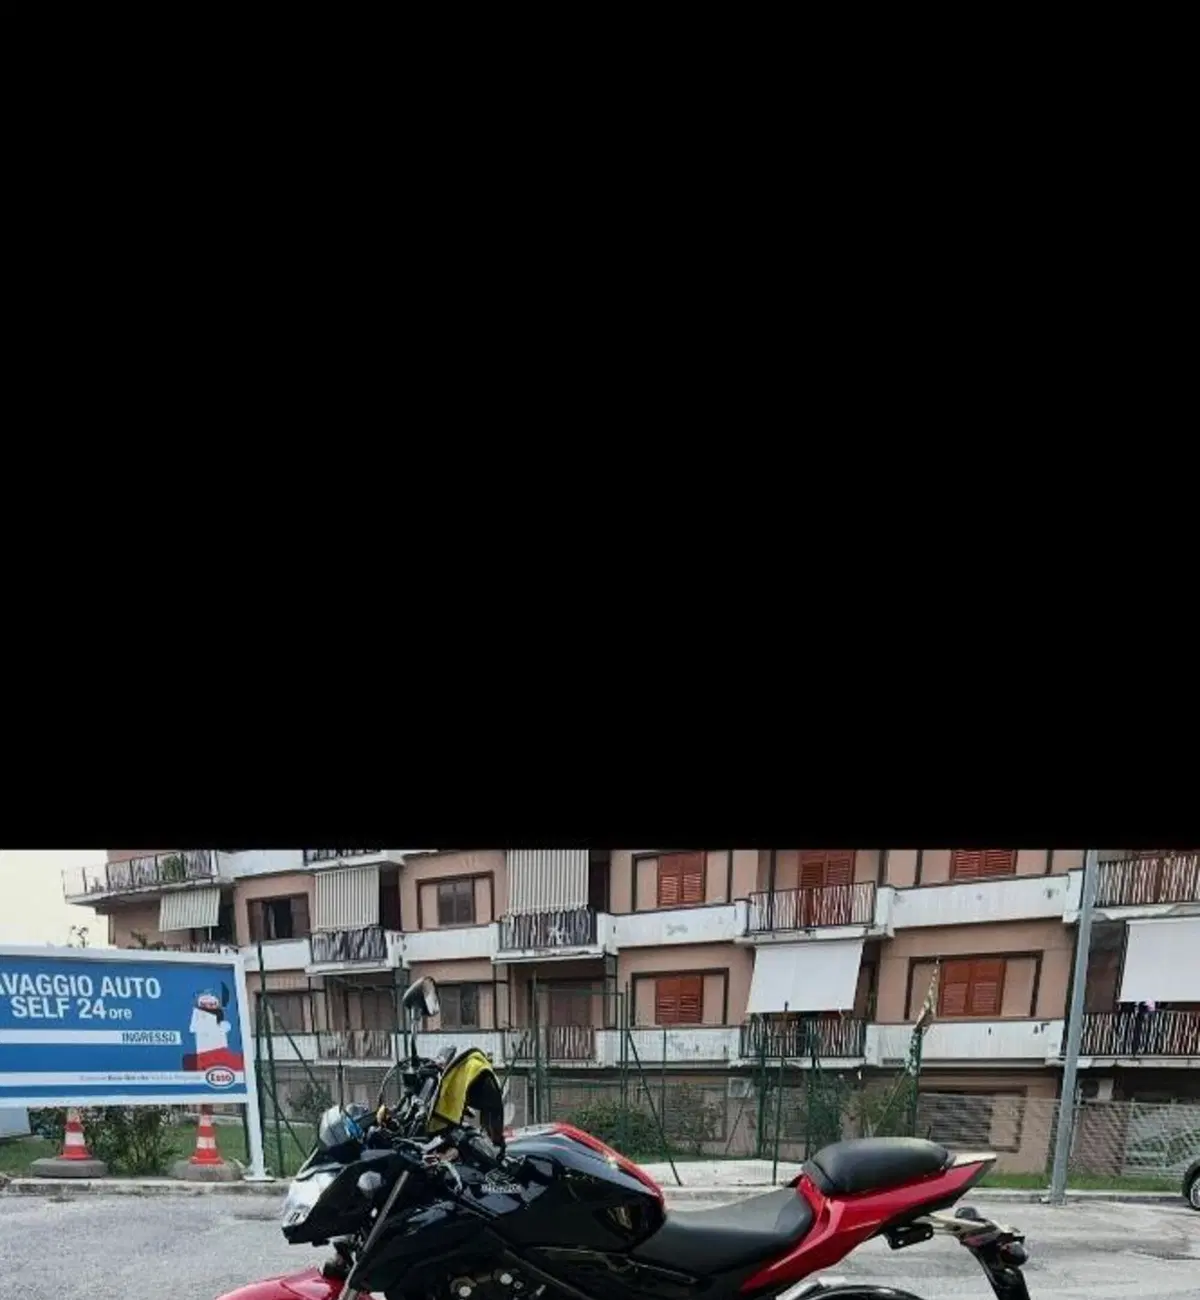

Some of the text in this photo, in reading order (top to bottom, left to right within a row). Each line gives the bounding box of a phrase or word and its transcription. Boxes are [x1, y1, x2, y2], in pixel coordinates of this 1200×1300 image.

[100, 975, 161, 999] AUTO
[10, 996, 132, 1020] SELF 24 ore
[121, 1032, 177, 1044] INGRESSO
